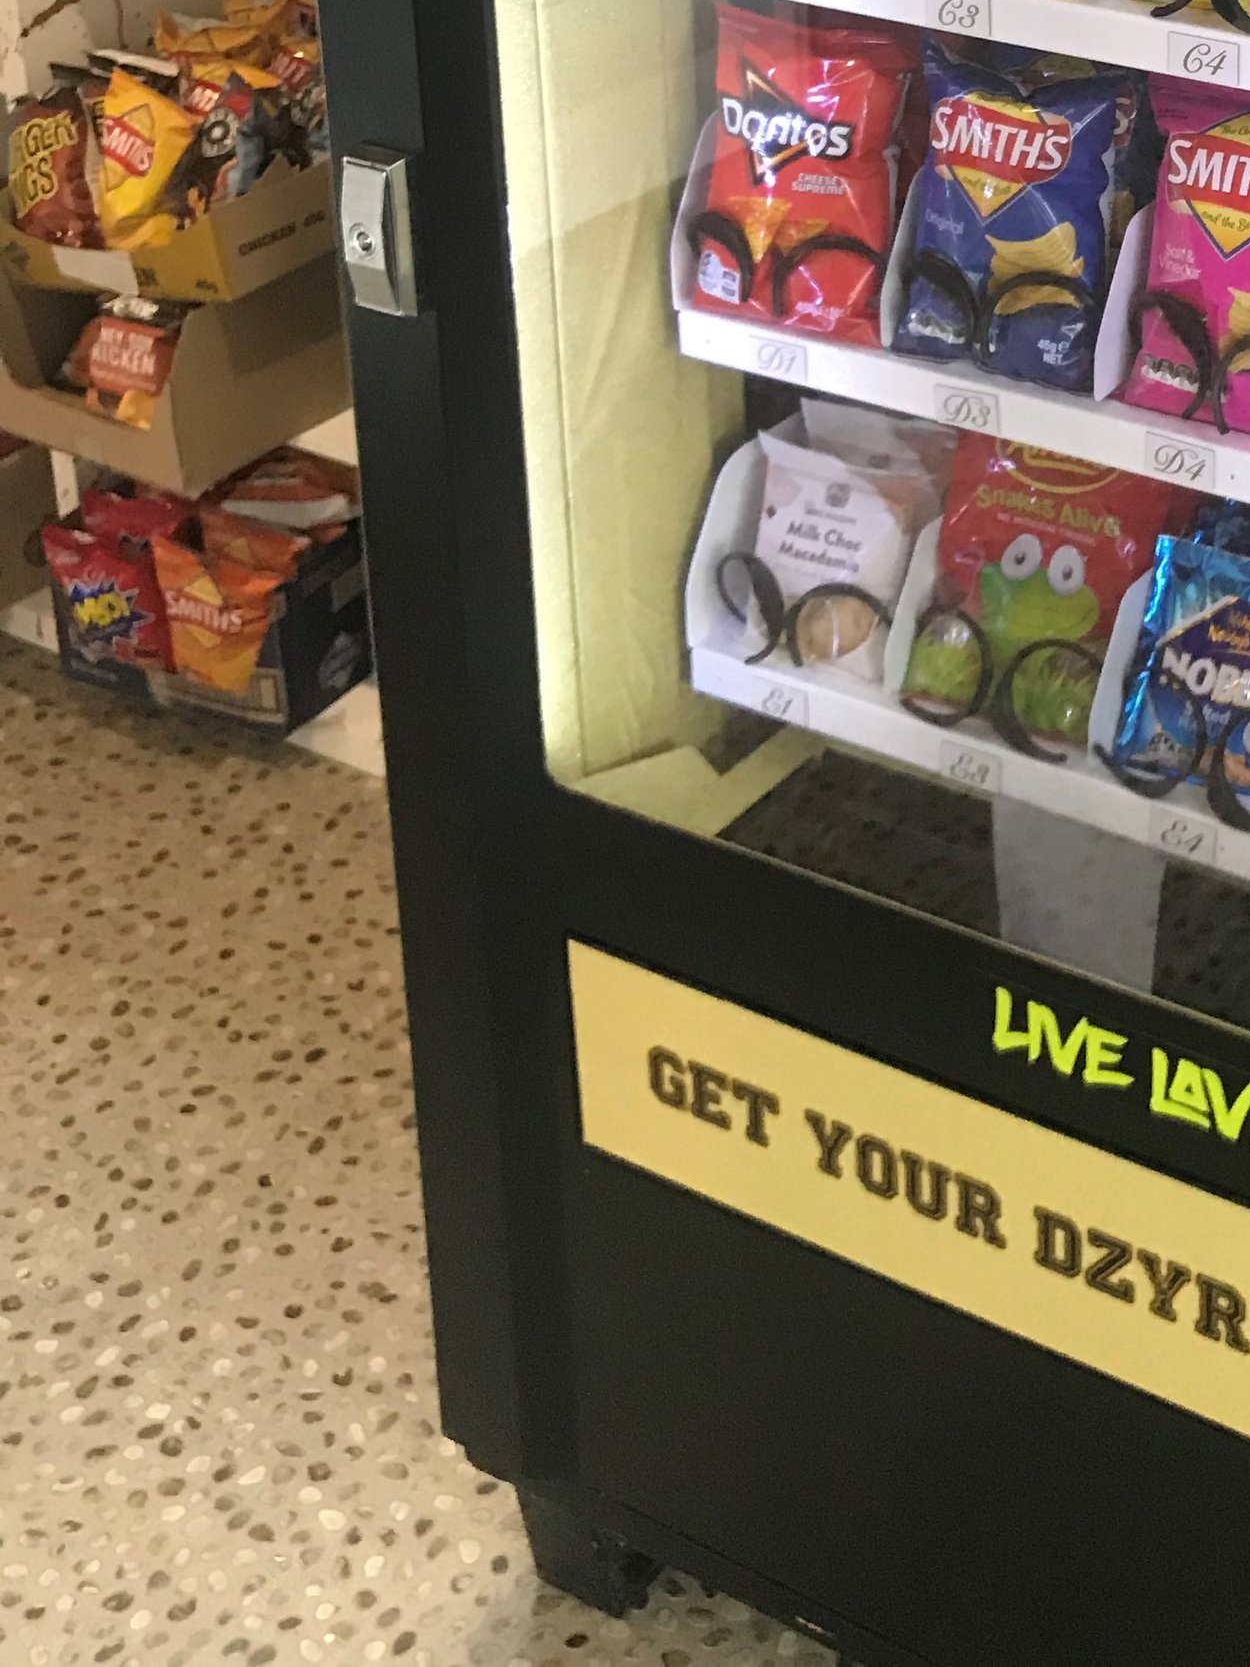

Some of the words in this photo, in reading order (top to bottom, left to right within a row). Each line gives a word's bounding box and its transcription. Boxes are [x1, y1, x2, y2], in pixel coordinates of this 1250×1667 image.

[721, 97, 850, 158] Doritos
[932, 106, 1069, 171] SMITH'S
[1155, 443, 1208, 482] D4
[991, 986, 1135, 1088] LIVE
[646, 1043, 781, 1148] GET
[805, 1106, 1007, 1249] YOUR
